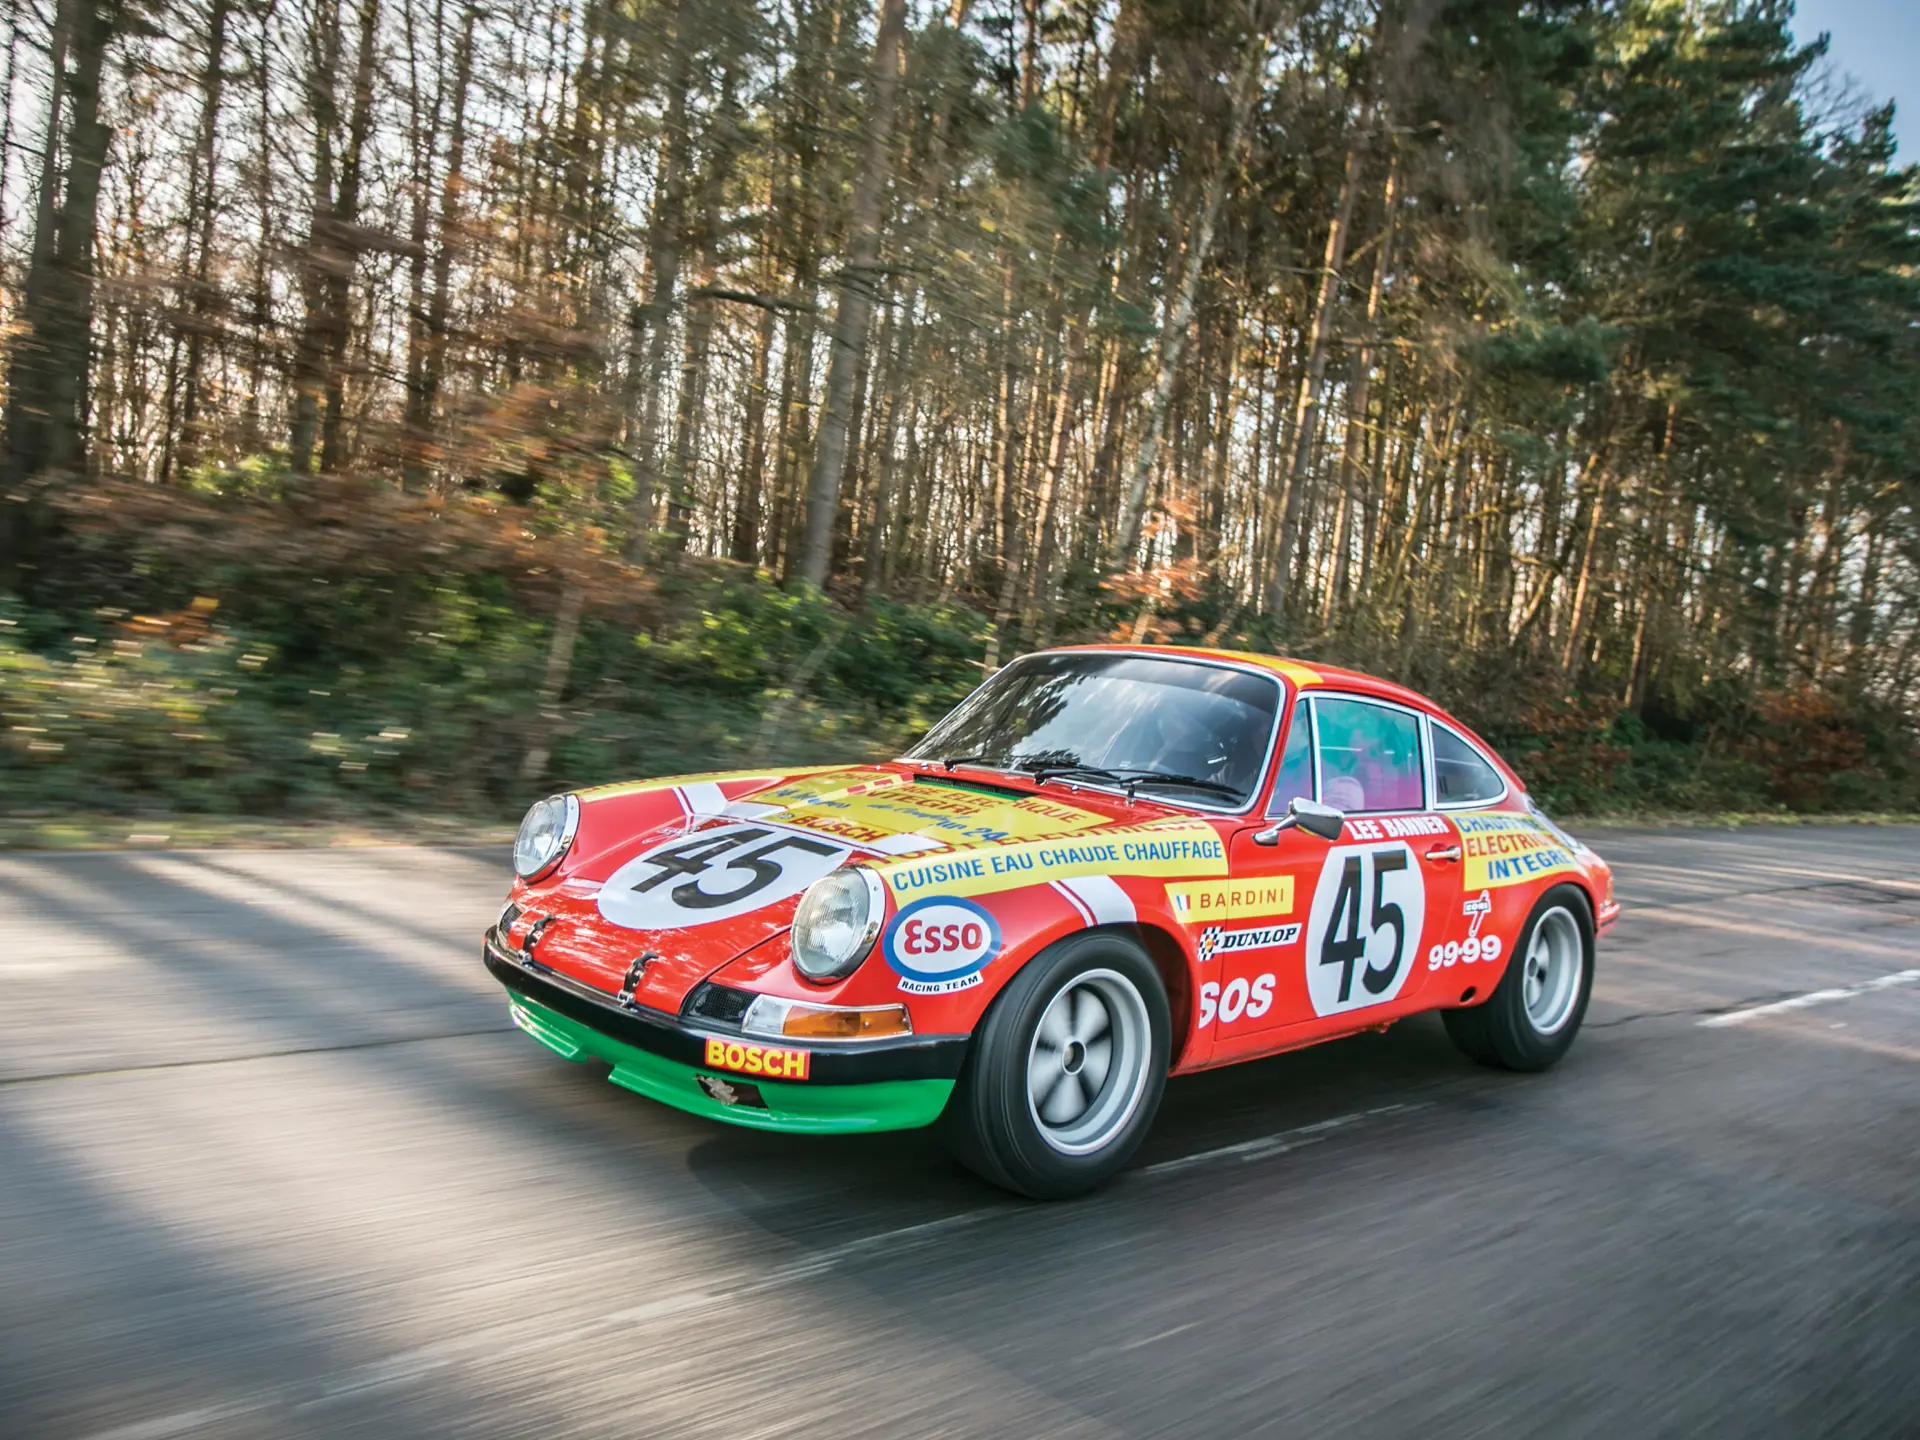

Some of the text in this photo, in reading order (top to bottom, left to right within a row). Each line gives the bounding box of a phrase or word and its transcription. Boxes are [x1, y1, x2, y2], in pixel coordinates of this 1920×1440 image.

[943, 792, 1087, 823] ELECRIQUE
[789, 815, 889, 842] BOSCH
[1344, 815, 1450, 840] LEE BANNER
[630, 827, 845, 908] 45
[893, 840, 1222, 891] CUISINE EAU CHAUDE CHAUFFAGE
[1200, 888, 1284, 909] BARDINI
[1221, 927, 1297, 949] DUNLOP
[1319, 849, 1408, 1003] 45
[901, 975, 979, 992] RACING TEAM
[1198, 973, 1276, 1029] SOS
[708, 1039, 806, 1077] BOSCH
